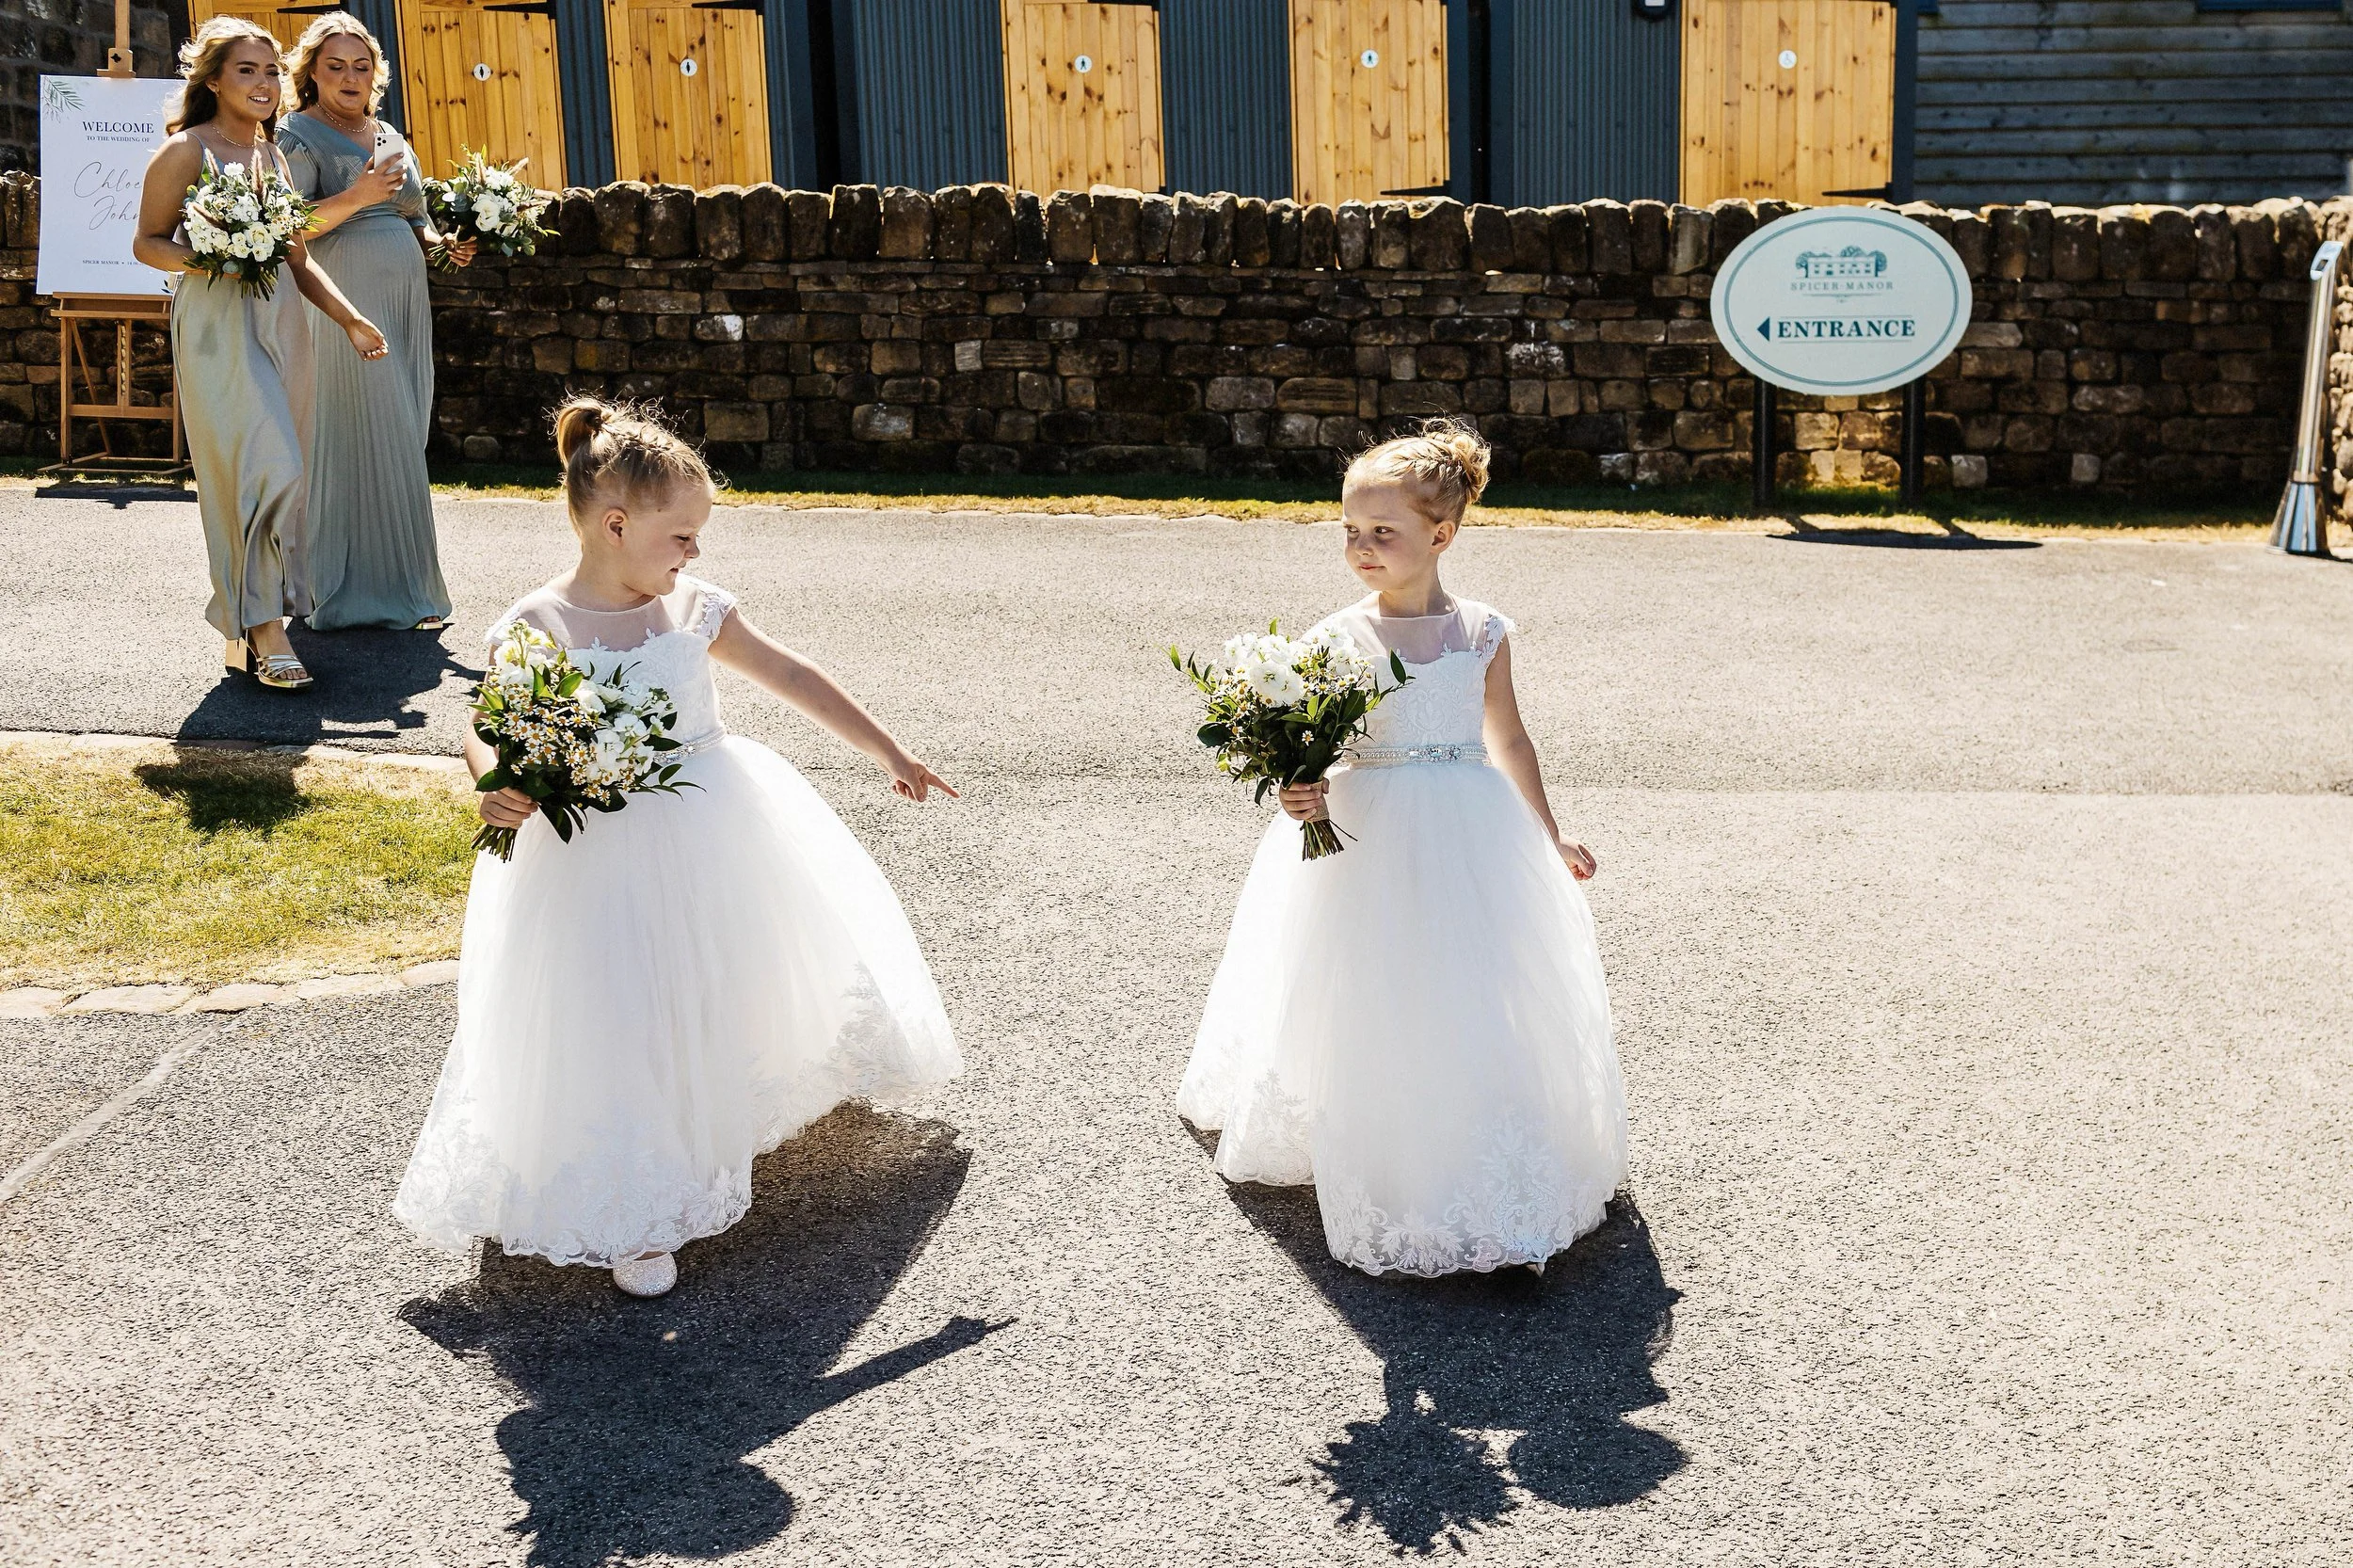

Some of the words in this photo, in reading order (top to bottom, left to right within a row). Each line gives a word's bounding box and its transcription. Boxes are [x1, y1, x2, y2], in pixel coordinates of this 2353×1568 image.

[82, 121, 154, 134] WELCOME
[73, 161, 142, 199] Chloe
[1790, 281, 1840, 291] SPICER
[1846, 280, 1894, 290] MANOR
[1777, 319, 1916, 338] ENTRANCE
